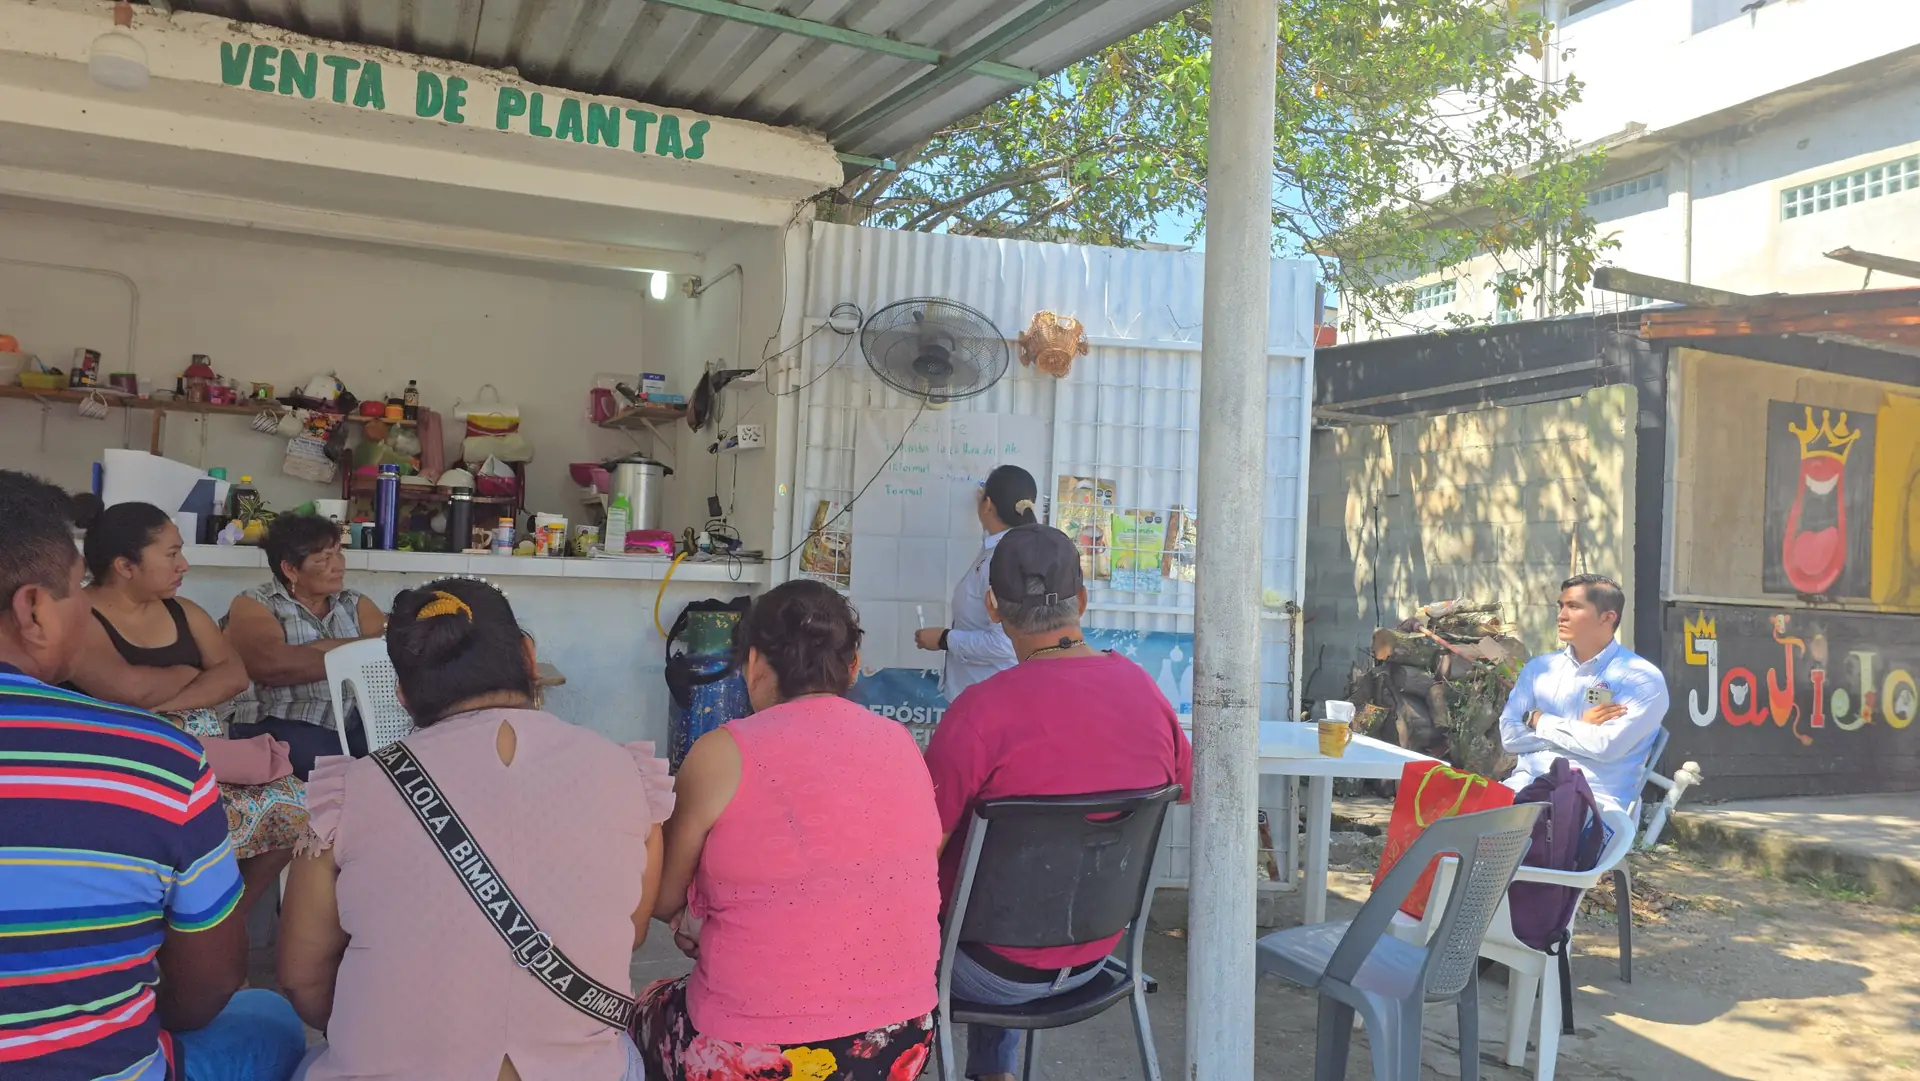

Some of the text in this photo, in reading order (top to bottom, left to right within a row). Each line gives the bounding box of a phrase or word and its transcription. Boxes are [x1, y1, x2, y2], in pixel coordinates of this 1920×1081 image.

[220, 42, 711, 160] VENTA DE PLANTAS
[866, 701, 945, 724] EPÓSIT
